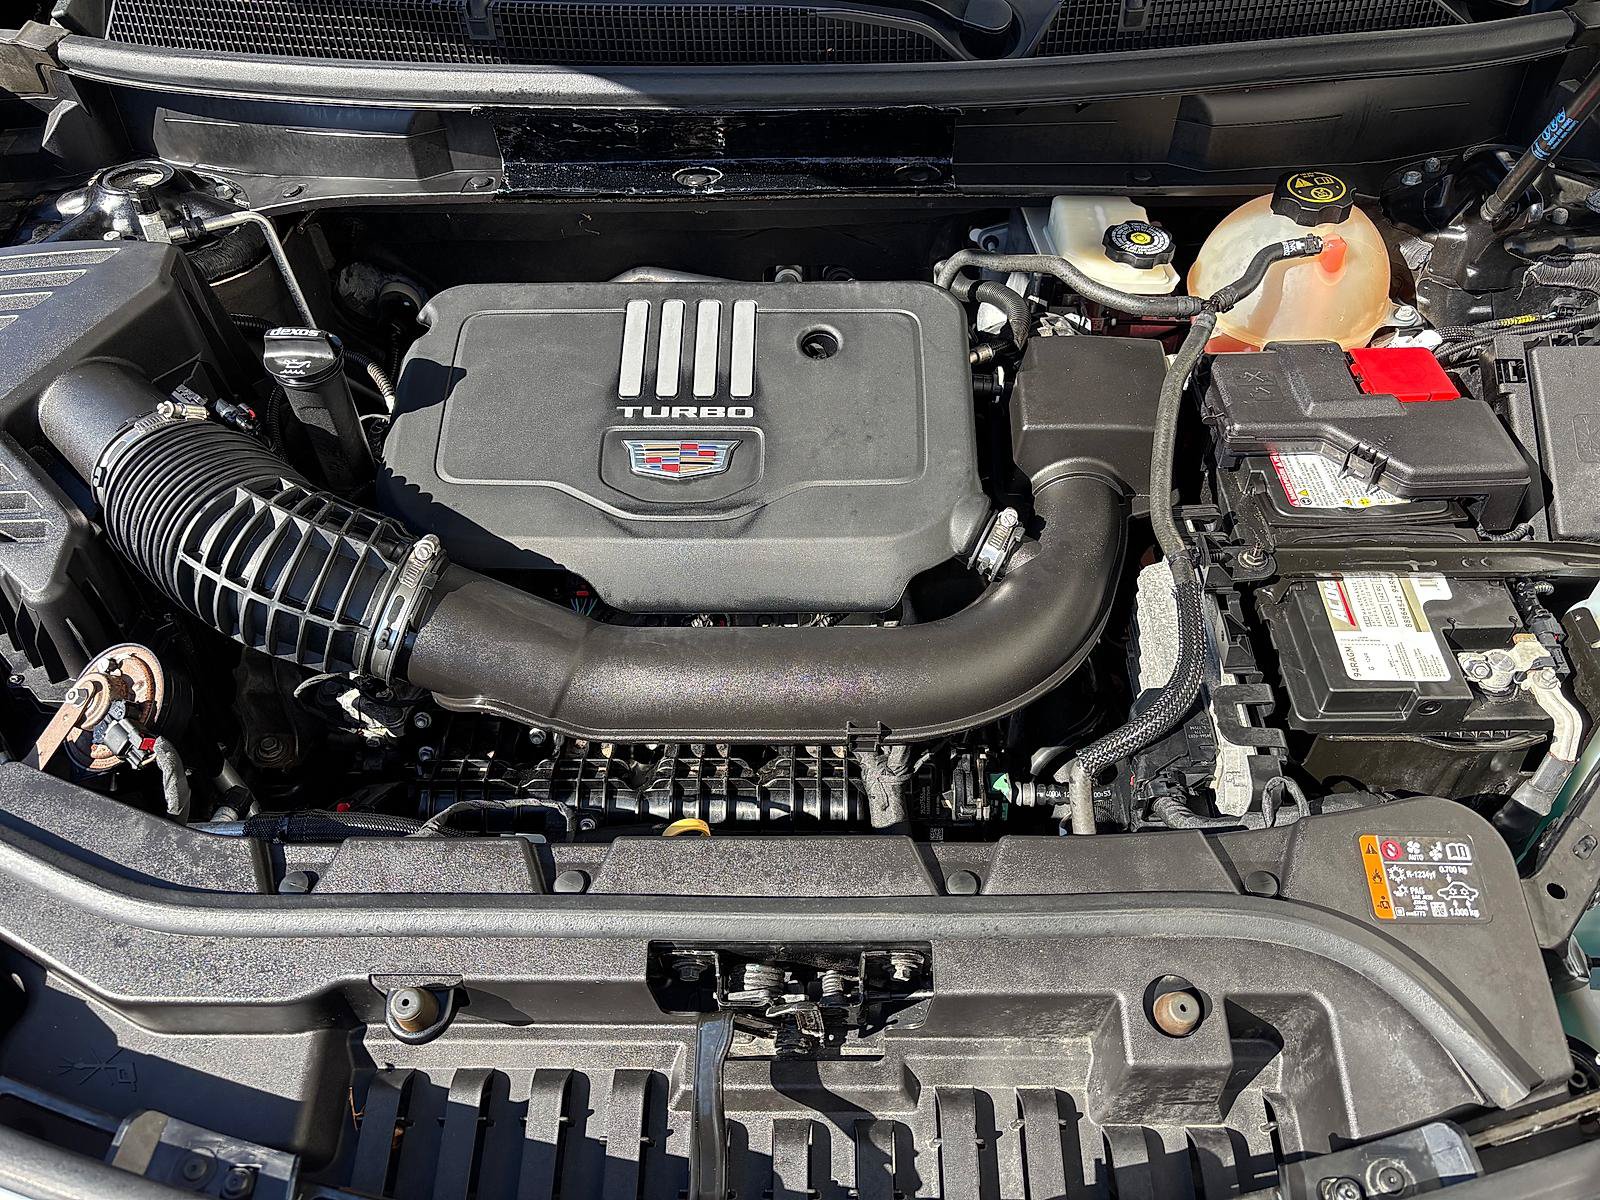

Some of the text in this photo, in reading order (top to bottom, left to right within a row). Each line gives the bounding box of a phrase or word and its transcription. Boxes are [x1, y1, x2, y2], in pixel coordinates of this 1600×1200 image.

[270, 327, 320, 336] dexos
[617, 406, 754, 418] TURBO
[1439, 866, 1468, 875] 0.700 kg
[1449, 908, 1469, 917] 1.000
